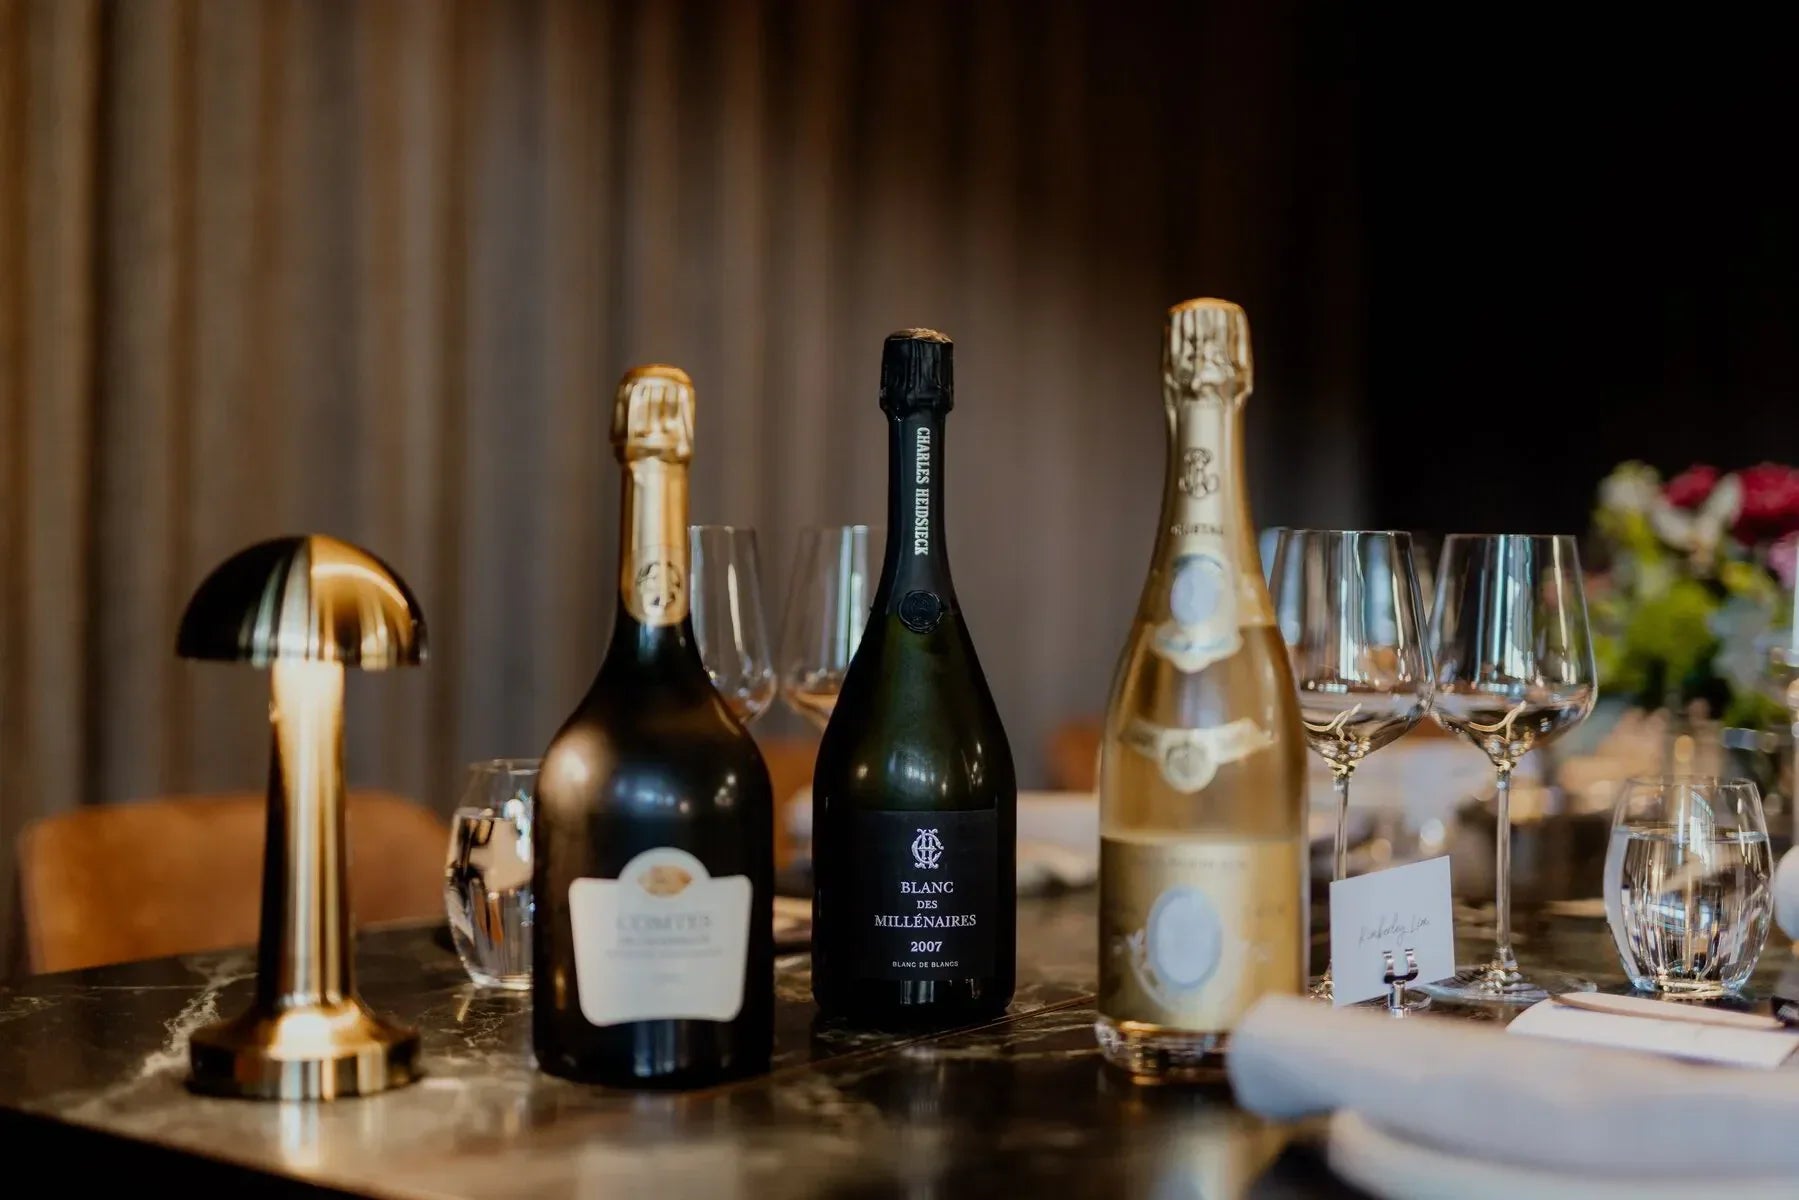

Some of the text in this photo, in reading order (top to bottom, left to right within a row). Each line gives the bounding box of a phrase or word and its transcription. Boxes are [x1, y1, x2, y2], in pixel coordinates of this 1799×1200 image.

[914, 427, 931, 556] CHARLES HEIDSIECK
[900, 881, 954, 894] BLANC
[916, 900, 938, 909] DES
[874, 913, 977, 928] MILLÉNAIRES
[910, 940, 943, 953] 2007
[931, 960, 959, 968] BLANCS
